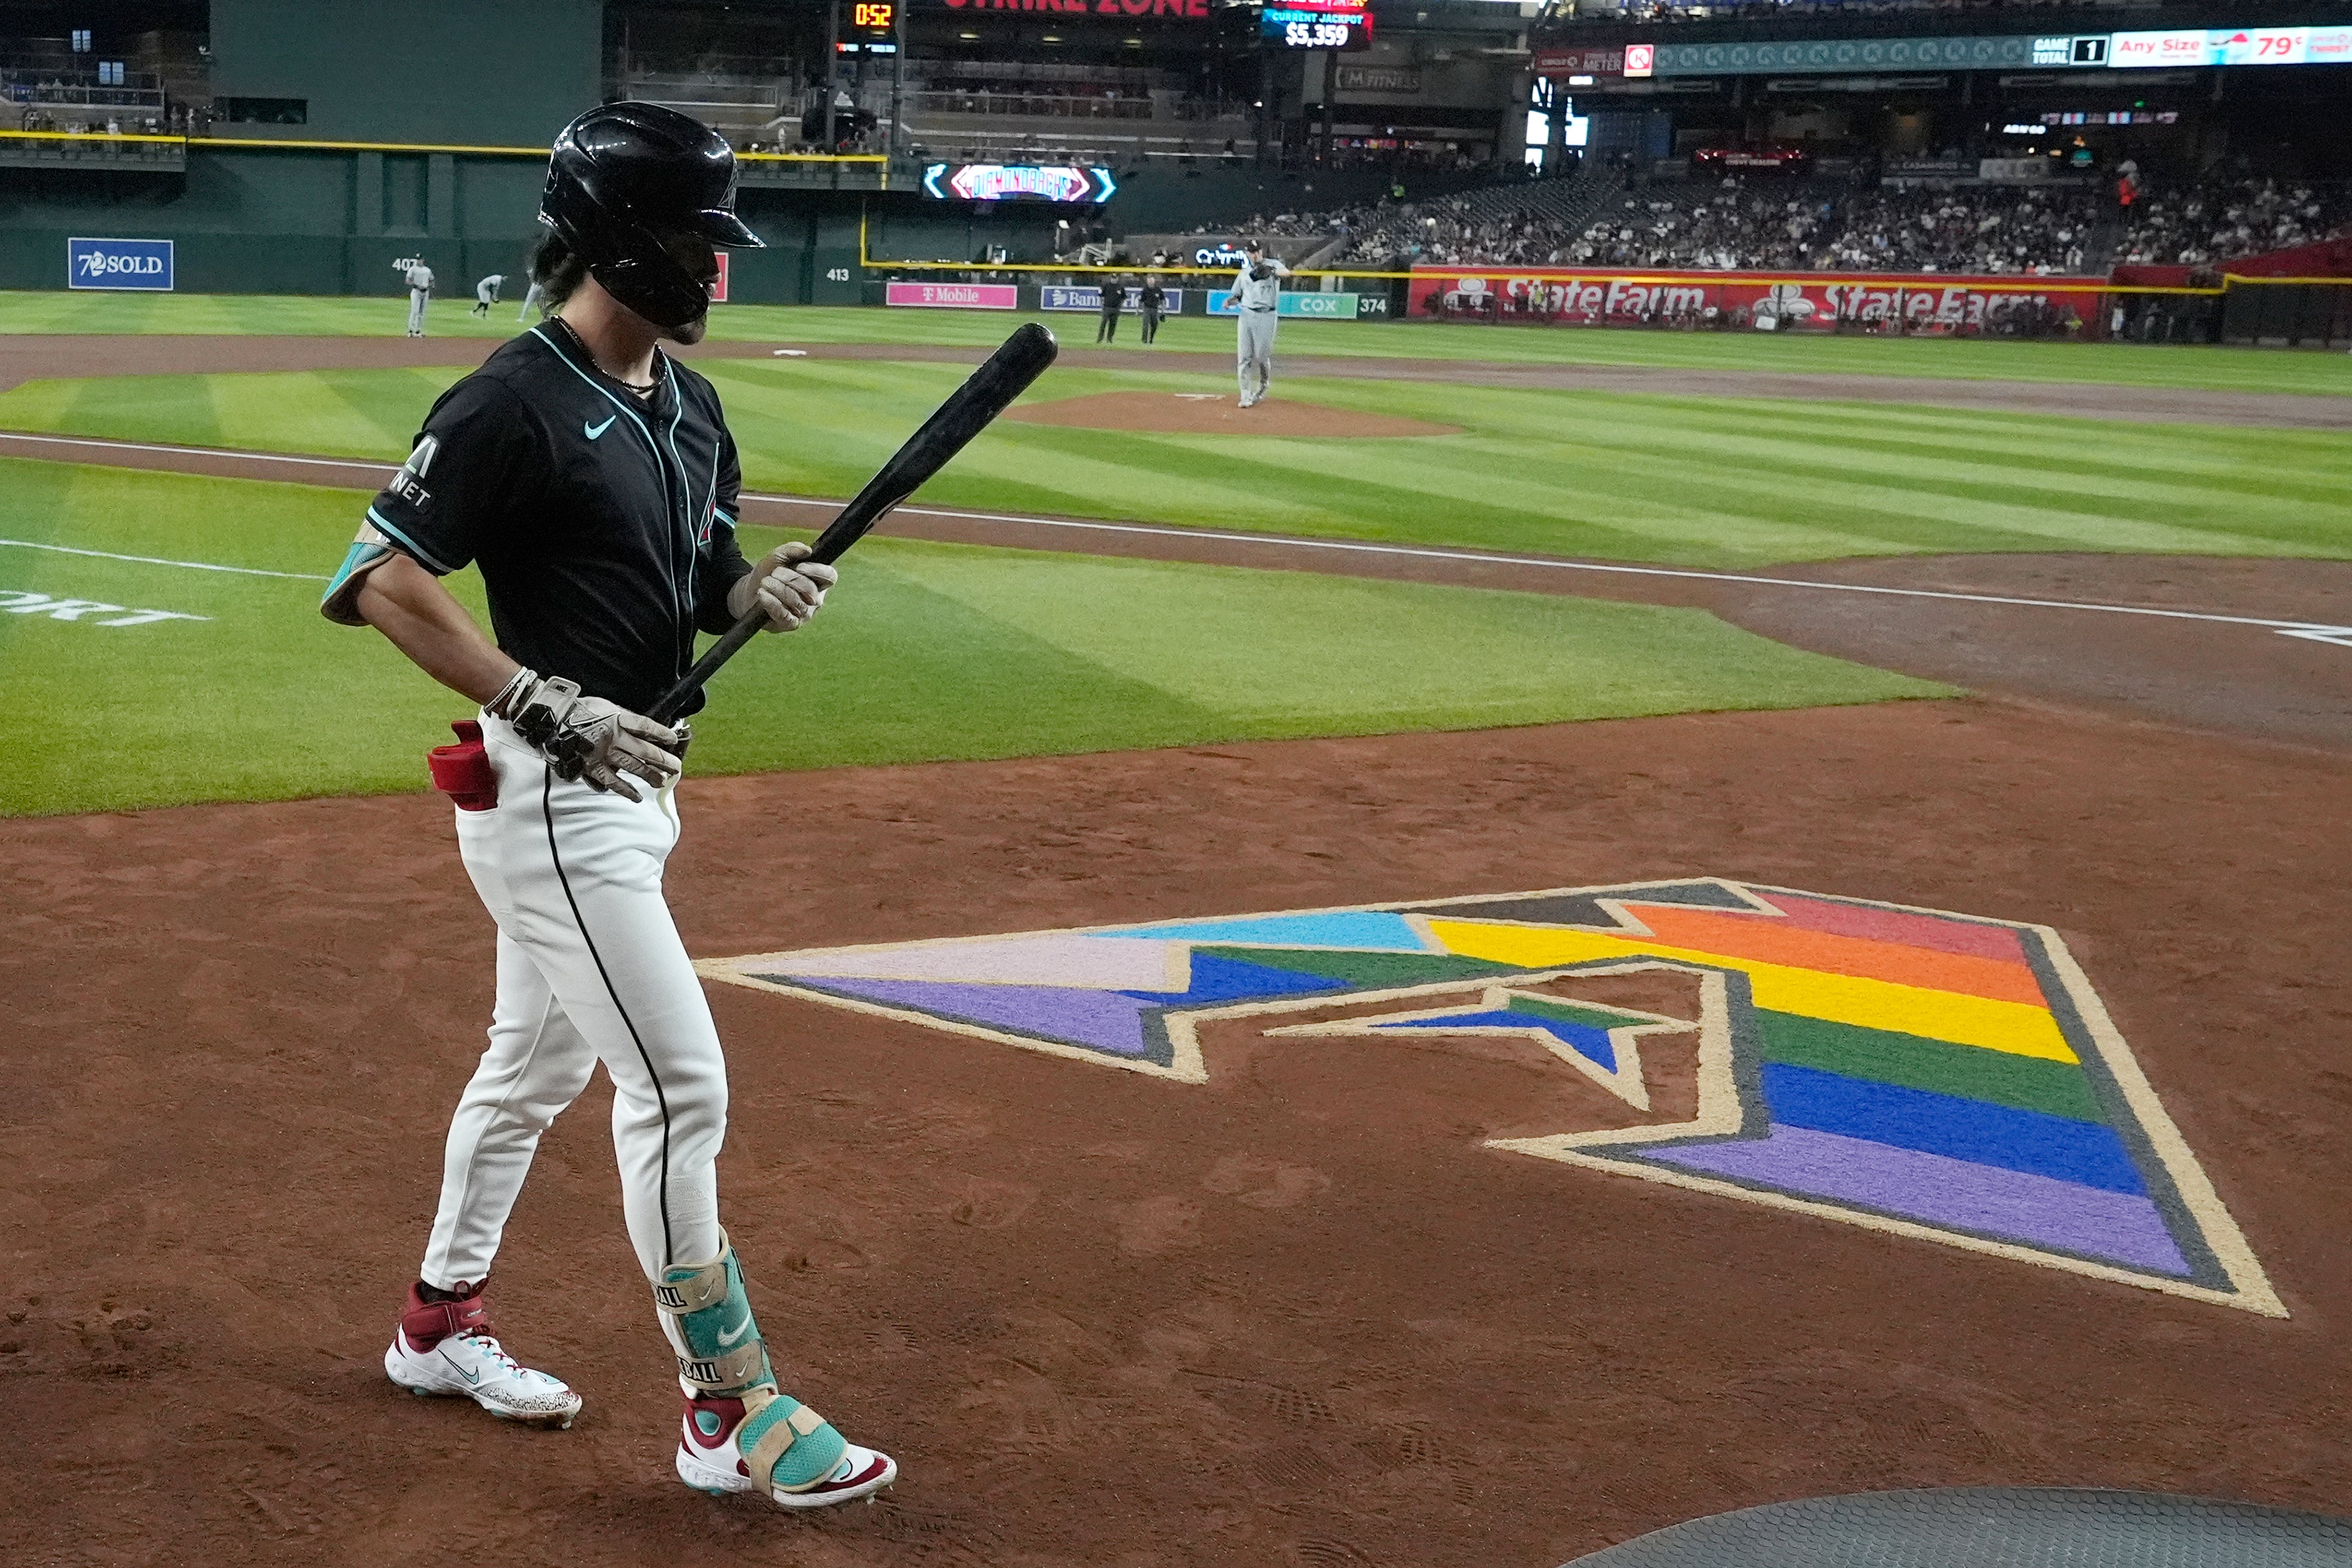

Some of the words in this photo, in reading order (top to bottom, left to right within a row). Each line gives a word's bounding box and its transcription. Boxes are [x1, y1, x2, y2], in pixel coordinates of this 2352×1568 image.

[856, 4, 891, 25] 0:52
[1272, 12, 1317, 22] CURRENT
[1318, 14, 1363, 24] JACKPOT
[1285, 22, 1348, 47] $5,359
[2034, 38, 2070, 51] GAME
[2087, 41, 2097, 60] 1
[2120, 41, 2155, 54] Any
[2163, 39, 2200, 51] Size
[2033, 52, 2068, 64] TOTAL
[972, 169, 1071, 200] DIAMONDBACKS
[392, 258, 418, 270] 407
[826, 269, 849, 282] 413
[936, 287, 979, 302] Mobile
[1300, 298, 1337, 312] COX
[1360, 299, 1386, 313] 374
